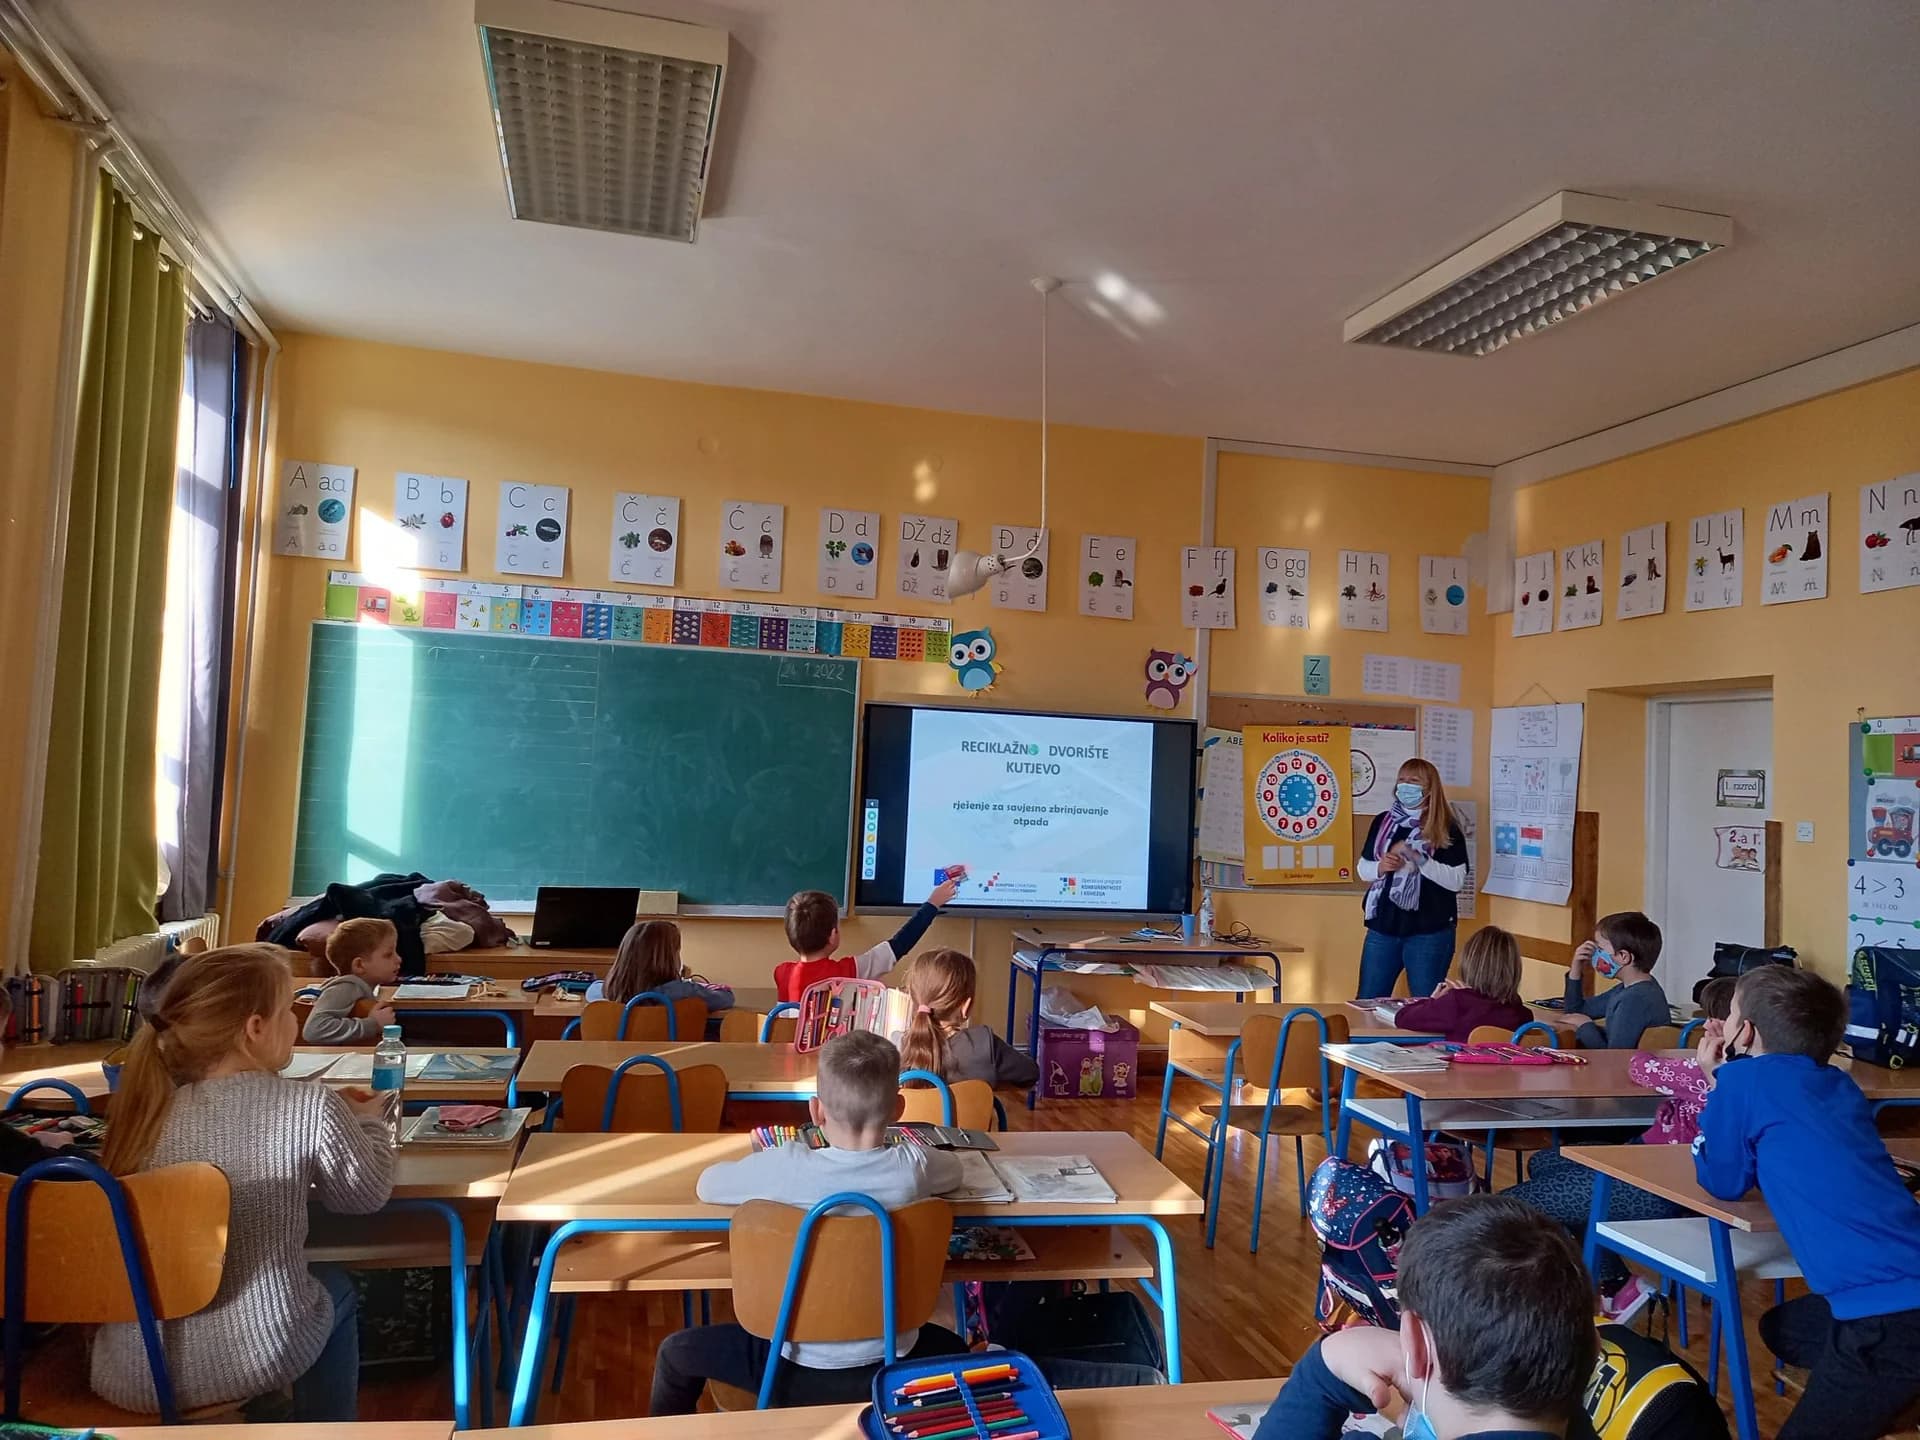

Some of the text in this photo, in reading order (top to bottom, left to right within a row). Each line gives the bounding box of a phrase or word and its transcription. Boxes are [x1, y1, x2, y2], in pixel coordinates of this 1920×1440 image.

[288, 464, 308, 489] A
[406, 477, 455, 504] B b
[508, 486, 555, 511] C c
[1869, 485, 1918, 514] N n
[621, 496, 667, 526] Č č
[728, 504, 772, 533] Ć ć
[1769, 505, 1821, 532] M m
[829, 511, 868, 537] D d
[1695, 516, 1734, 547] LJ lj
[901, 518, 952, 549] DŽ dž
[998, 528, 1015, 550] Đ
[1088, 537, 1126, 561] E e
[1627, 535, 1637, 556] L
[1187, 549, 1198, 569] F
[1265, 550, 1278, 570] G
[1345, 554, 1382, 576] H h
[1566, 550, 1577, 571] K
[826, 575, 865, 592] D d
[655, 596, 665, 604] 10
[683, 599, 692, 607] 11
[711, 601, 722, 609] 12
[742, 603, 752, 611] 13
[931, 619, 943, 627] 20
[1309, 658, 1321, 677] Z
[1262, 732, 1330, 746] Koliko je sati?
[1048, 744, 1109, 760] DVORIŠTE
[1005, 760, 1061, 776] KUTJEVO
[1278, 764, 1287, 773] 11
[1292, 759, 1302, 769] 12
[1307, 763, 1315, 773] 1
[1267, 775, 1278, 785] 10
[1317, 775, 1326, 784] 2
[1265, 791, 1272, 800] 9
[1322, 791, 1330, 800] 3
[952, 800, 1110, 817] rješenje za savjesno zbrinjavanje
[1268, 807, 1276, 816] 8
[1318, 807, 1326, 816] 4
[1013, 816, 1049, 828] otpada
[1279, 819, 1287, 828] 7
[1293, 823, 1301, 833] 6
[1307, 819, 1315, 828] 5
[1854, 875, 1867, 896] 4
[1894, 877, 1905, 899] 3
